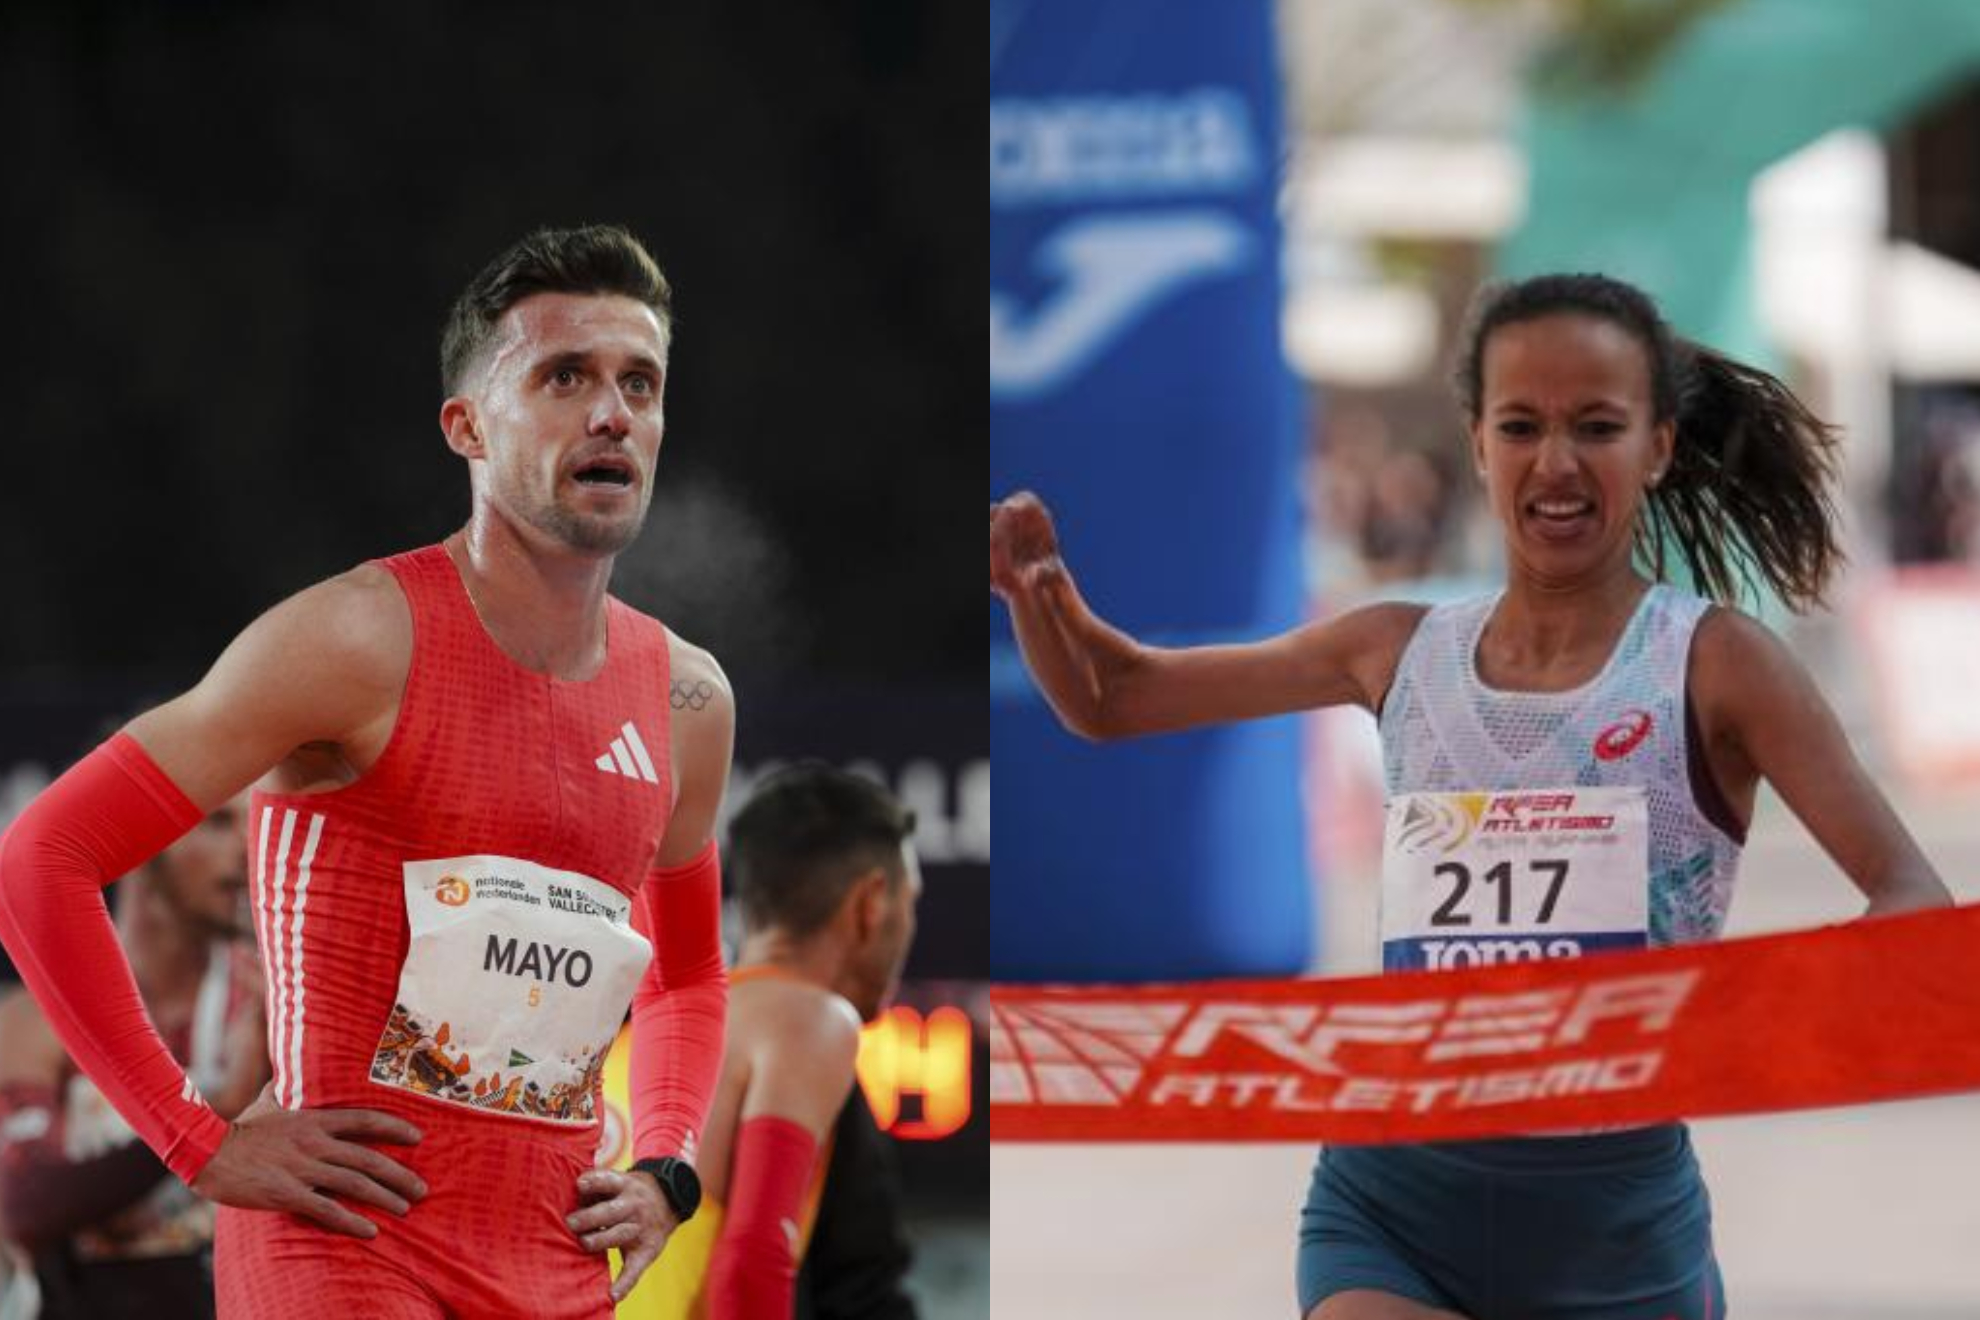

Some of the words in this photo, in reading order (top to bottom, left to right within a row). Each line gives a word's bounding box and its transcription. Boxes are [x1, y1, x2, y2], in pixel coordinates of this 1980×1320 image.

[1482, 815, 1616, 833] ATLETISMO
[475, 875, 525, 891] nationale
[547, 884, 572, 899] SAN
[1430, 859, 1570, 926] 217
[483, 933, 594, 988] MAYO
[528, 986, 542, 1007] 5
[1172, 967, 1700, 1076] RFEA
[1150, 1051, 1664, 1114] ATLETISMO
